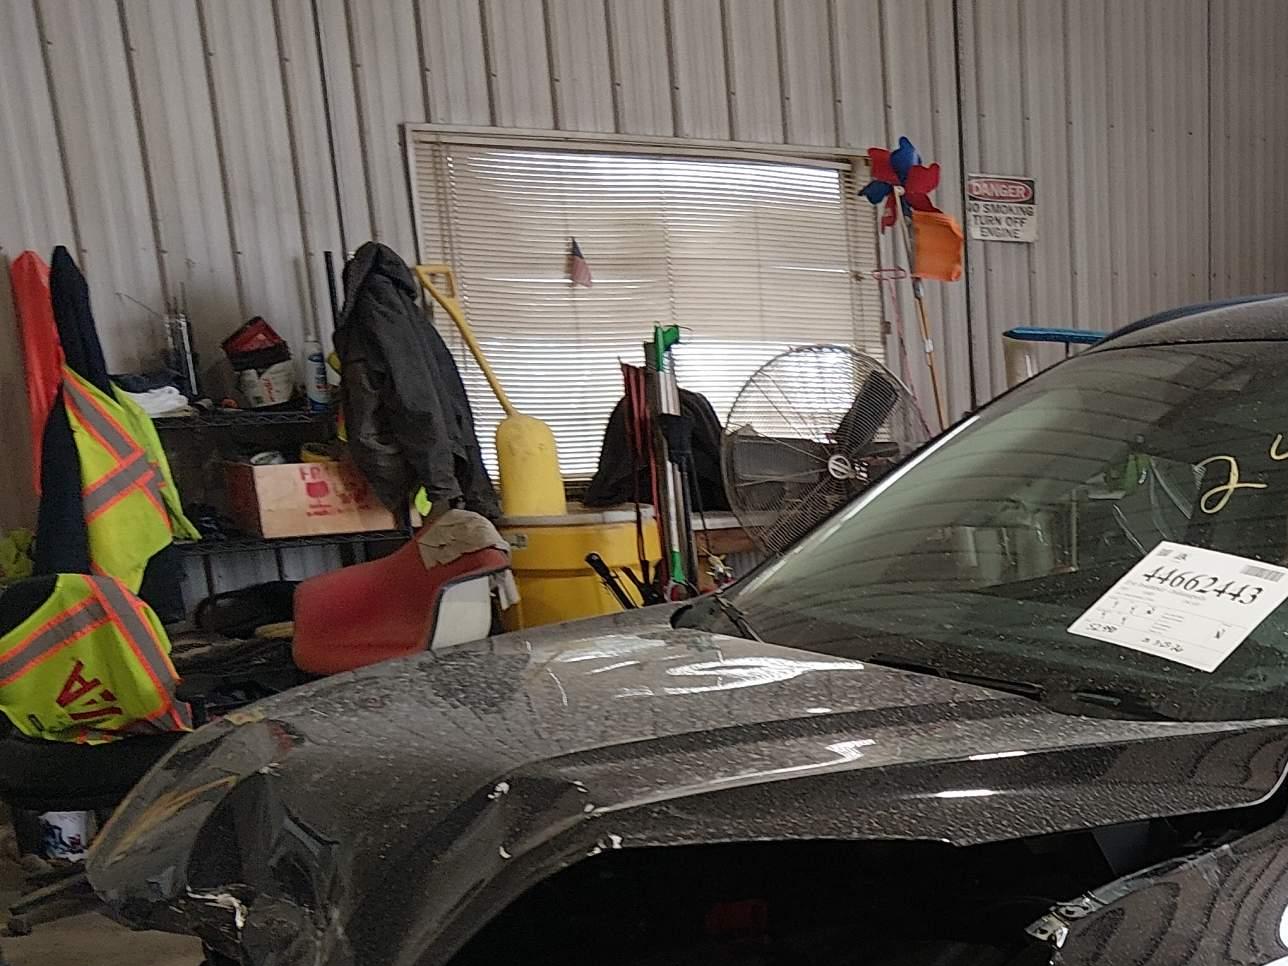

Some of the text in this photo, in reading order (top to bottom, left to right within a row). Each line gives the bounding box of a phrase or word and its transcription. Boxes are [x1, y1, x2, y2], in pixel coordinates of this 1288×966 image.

[972, 182, 1025, 198] DANGER
[983, 203, 1034, 217] SMOKING
[973, 214, 1028, 228] TURN OFF
[980, 226, 1020, 239] ENGINE
[1142, 565, 1264, 605] 44662443
